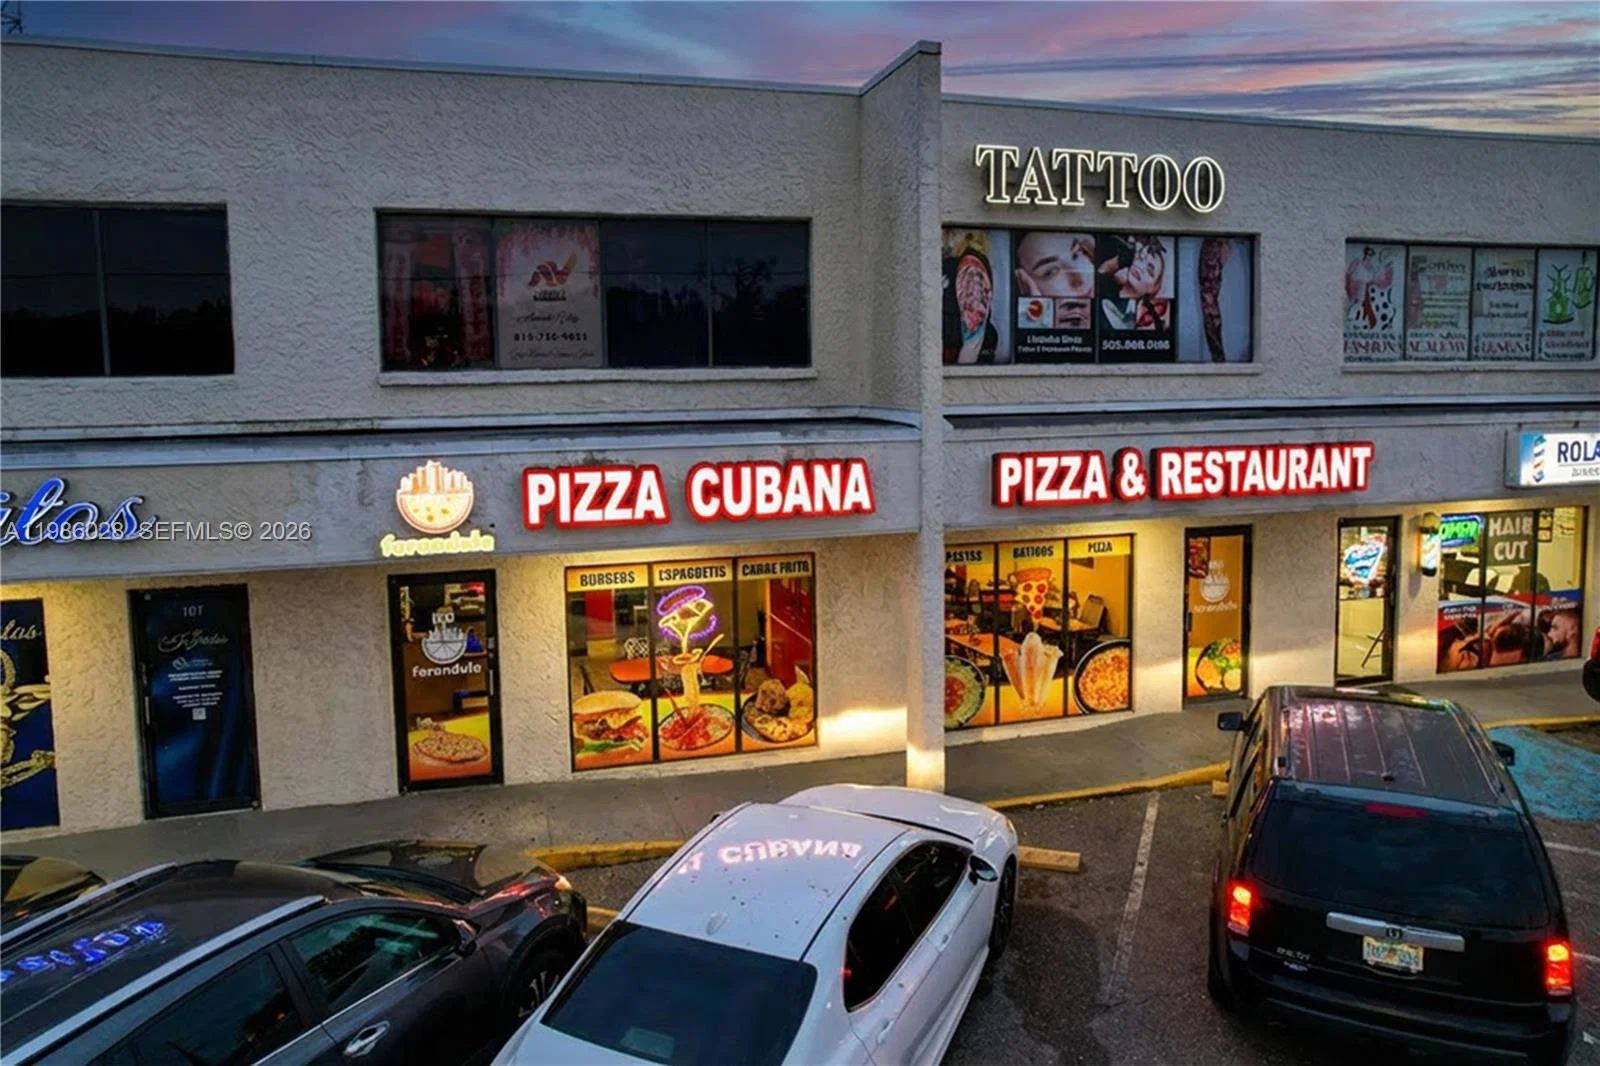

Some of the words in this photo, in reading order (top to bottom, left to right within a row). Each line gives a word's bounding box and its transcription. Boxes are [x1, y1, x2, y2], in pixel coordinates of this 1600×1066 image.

[975, 144, 1225, 213] TATTOO
[525, 467, 668, 527] PIZZA
[688, 461, 873, 520] CUBANA
[998, 454, 1109, 505] PIZZA
[1119, 451, 1147, 498] &
[1160, 446, 1372, 496] RESTAURANT
[1488, 516, 1533, 538] HAIR
[1493, 540, 1528, 560] CUT
